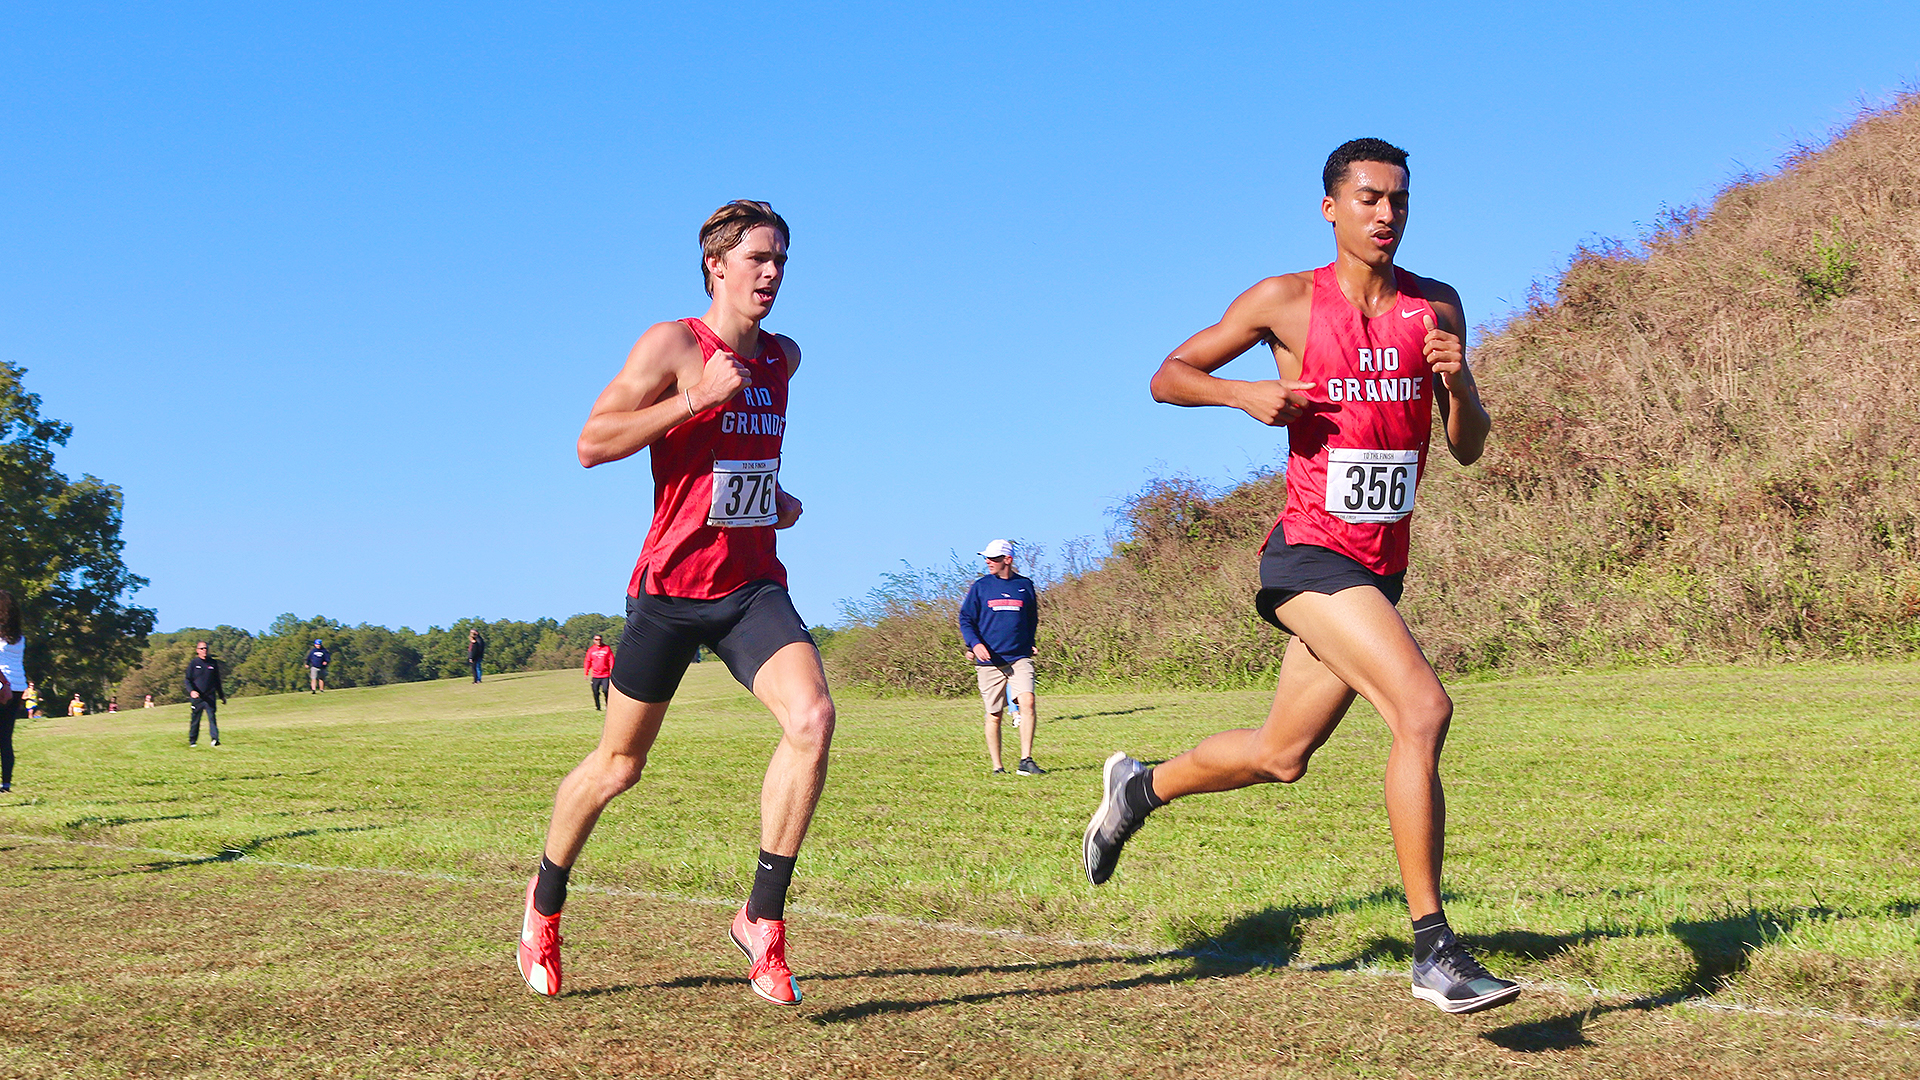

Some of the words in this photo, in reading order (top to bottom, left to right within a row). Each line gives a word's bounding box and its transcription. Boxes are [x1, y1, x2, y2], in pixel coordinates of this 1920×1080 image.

[1357, 347, 1399, 372] RIO
[743, 387, 773, 406] RIO
[1327, 377, 1424, 402] GRANDE
[725, 474, 773, 516] 376
[1344, 465, 1408, 511] 356
